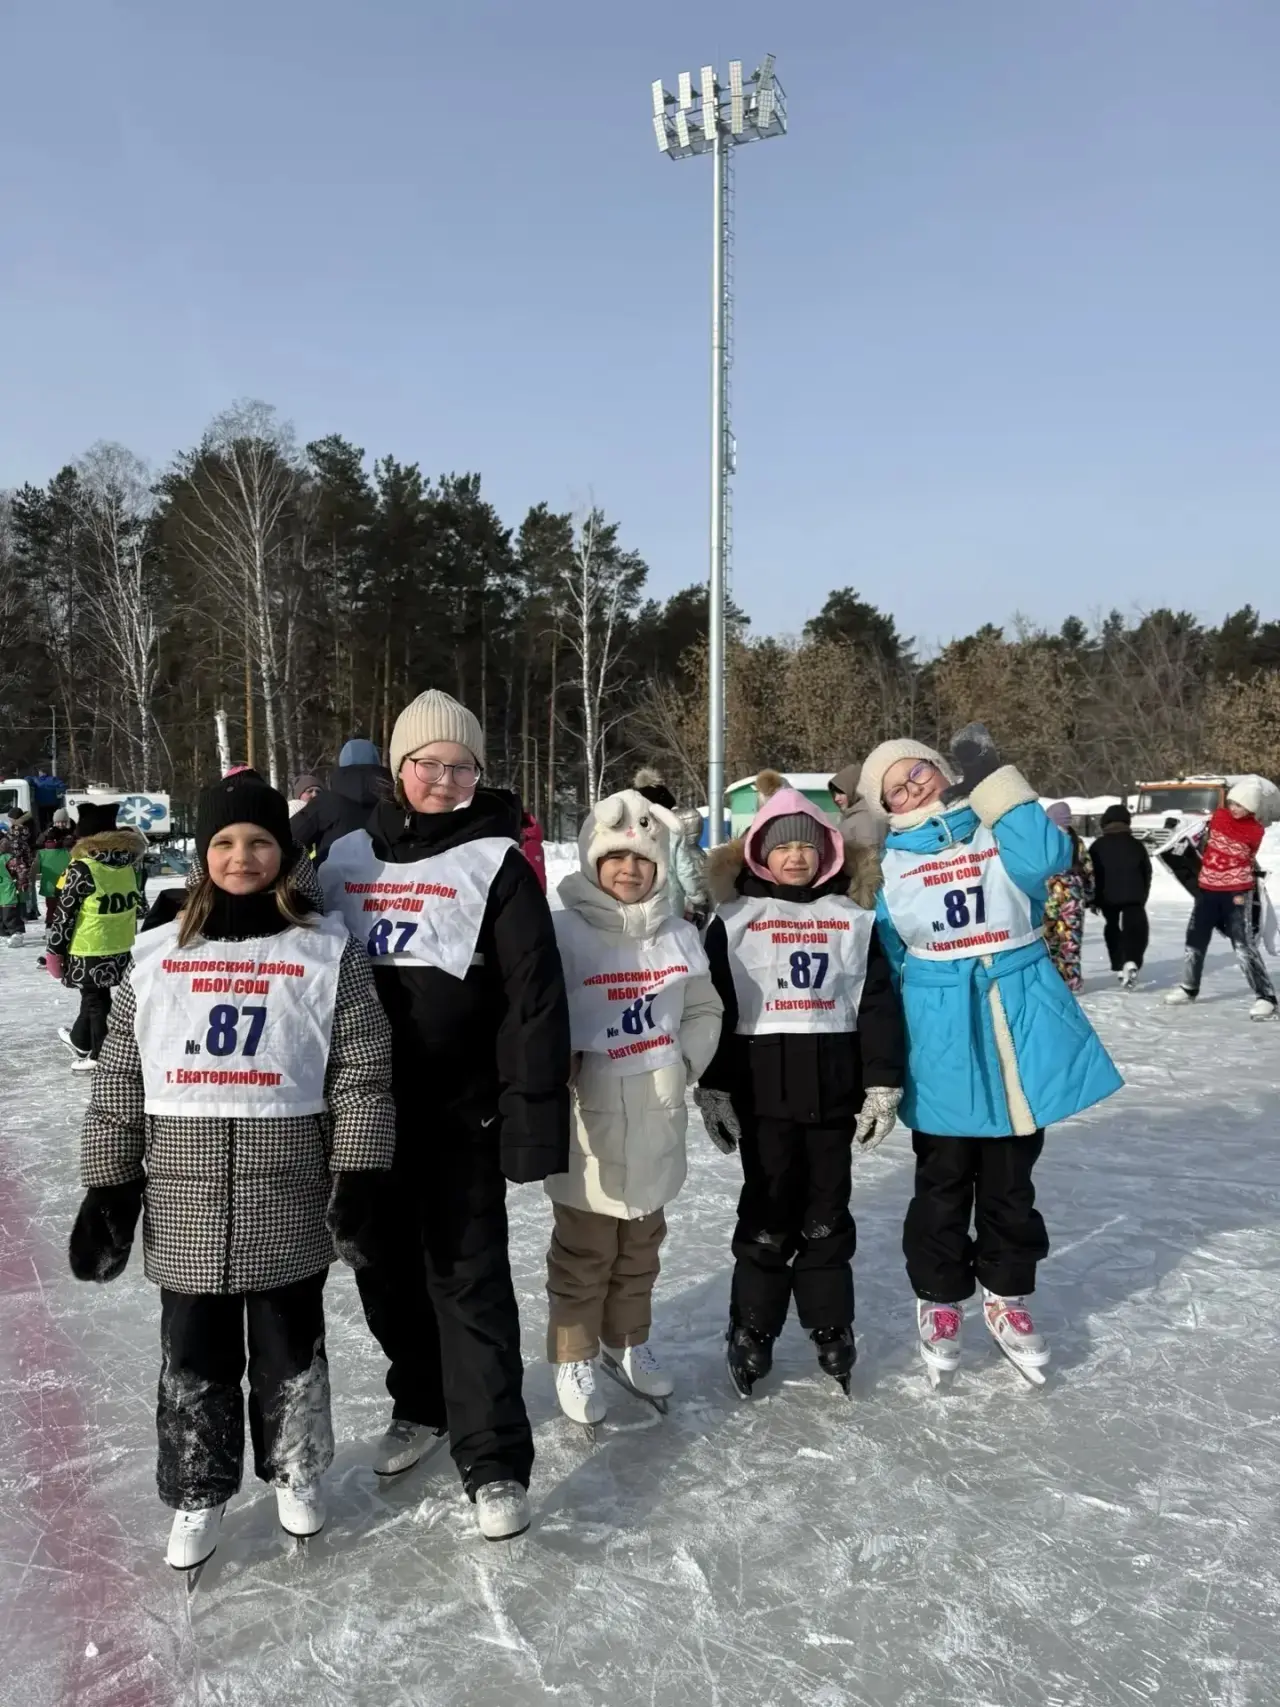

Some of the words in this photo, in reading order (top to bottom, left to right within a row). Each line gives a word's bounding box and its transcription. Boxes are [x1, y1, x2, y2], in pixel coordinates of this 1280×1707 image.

[923, 872, 954, 888] МБОУ
[956, 866, 982, 881] СОШ
[415, 882, 458, 899] район
[393, 898, 424, 912] СОШ
[944, 885, 986, 929] 87
[748, 918, 814, 932] Чкаловский
[817, 918, 850, 931] район
[367, 918, 418, 957] 87
[772, 932, 801, 944] МБОУ
[802, 933, 828, 944] СОШ
[932, 930, 1010, 952] Екатеринбург
[162, 959, 255, 974] Чкаловский
[258, 960, 305, 977] район
[789, 951, 829, 989] 87
[192, 978, 231, 993] МБОУ
[234, 979, 270, 994] СОШ
[607, 987, 638, 1001] МБОУ
[185, 1040, 201, 1054] №
[206, 1004, 267, 1056] 87
[166, 1071, 174, 1083] г.
[176, 1068, 282, 1086] Екатеринбург
